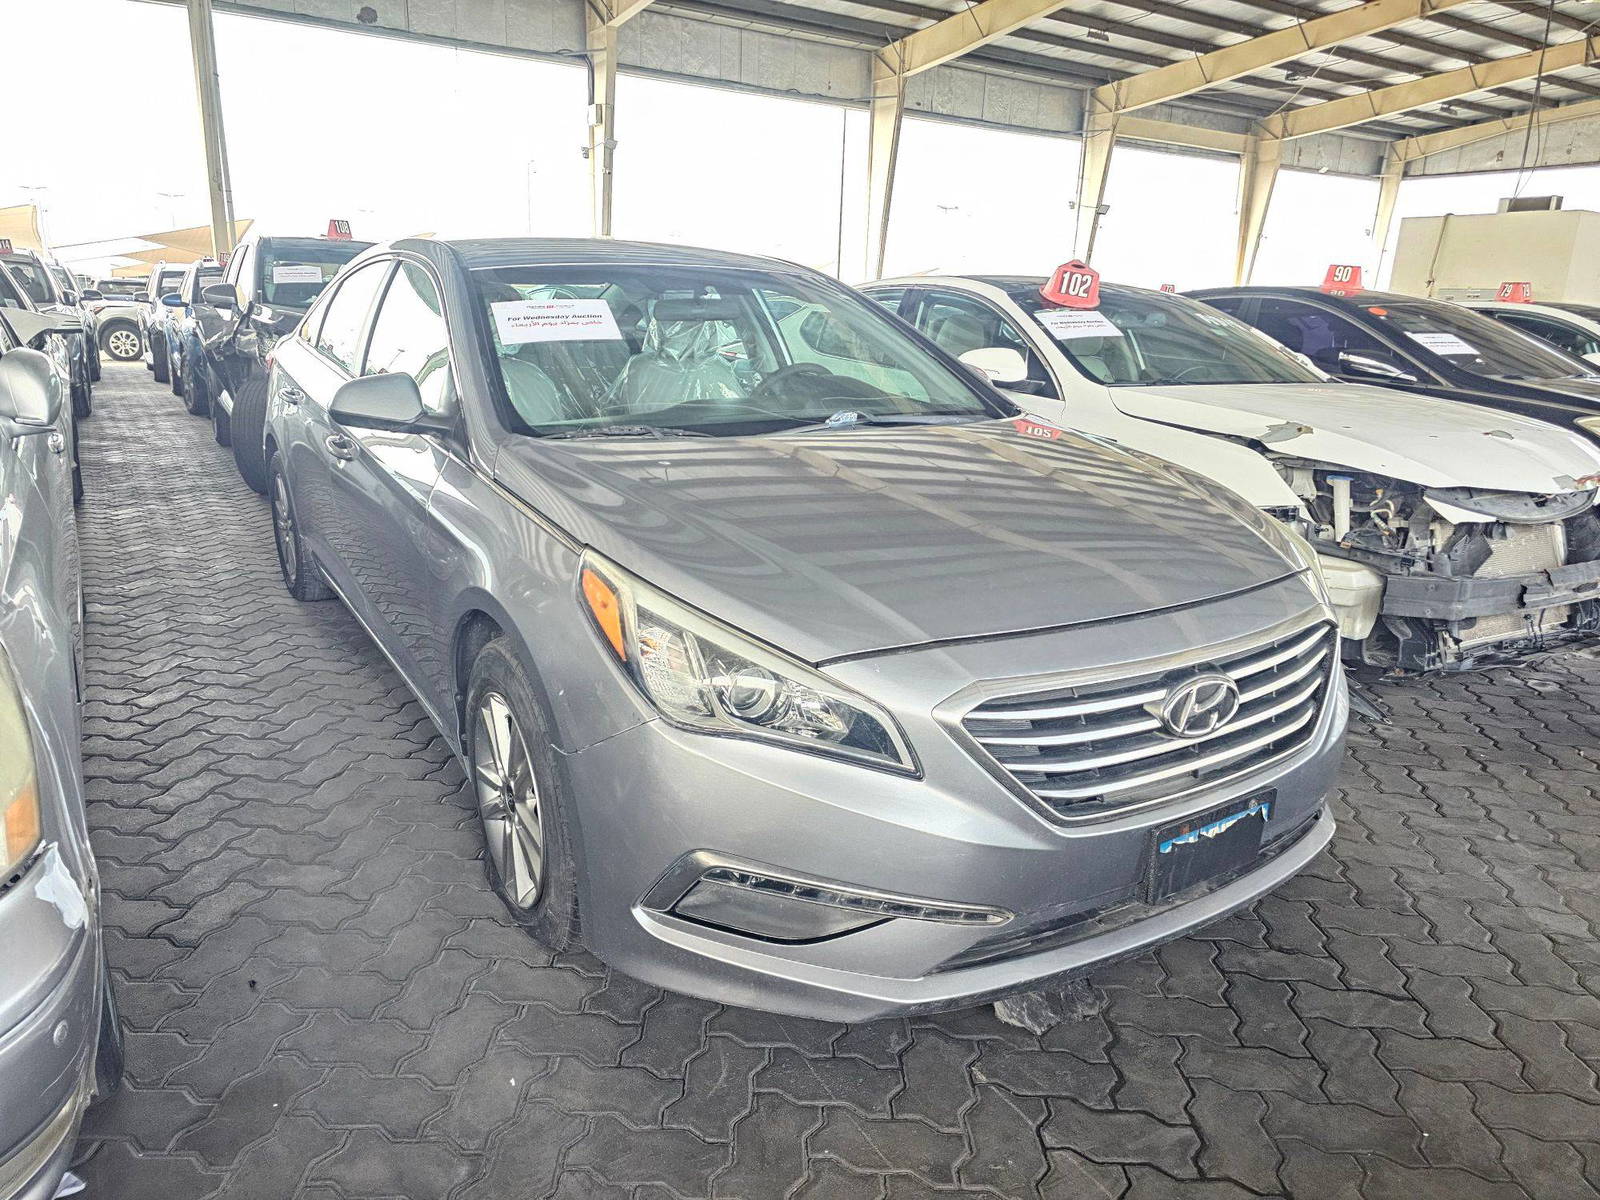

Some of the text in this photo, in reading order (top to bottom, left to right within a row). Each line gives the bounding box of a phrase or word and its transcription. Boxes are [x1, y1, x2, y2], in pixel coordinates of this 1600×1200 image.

[335, 220, 349, 234] 108
[1334, 266, 1352, 282] 90
[1061, 271, 1093, 298] 102
[1501, 284, 1513, 297] 79
